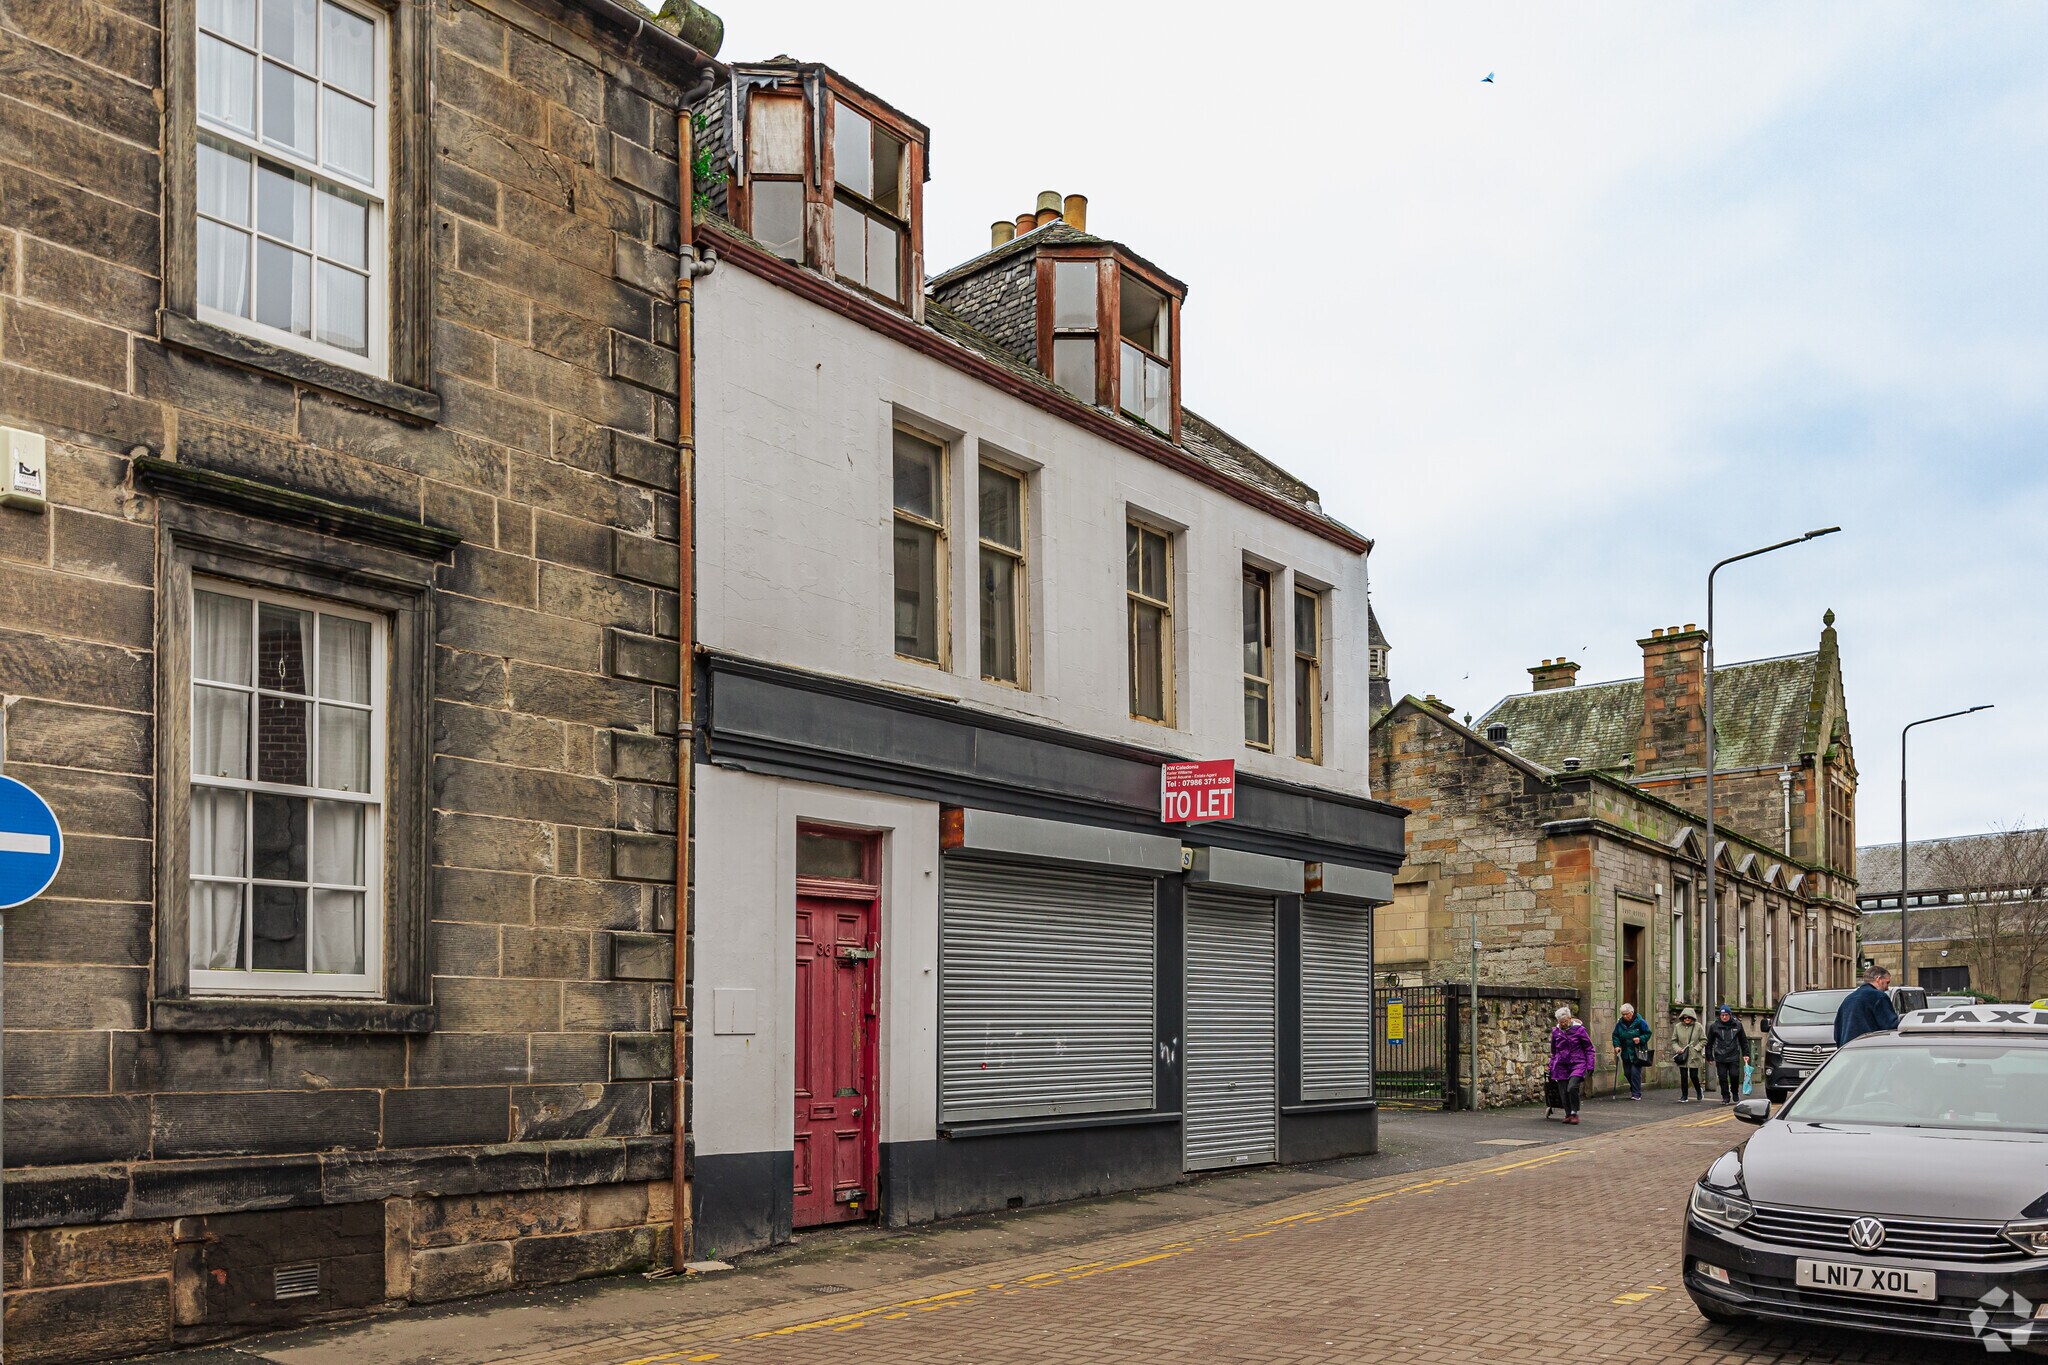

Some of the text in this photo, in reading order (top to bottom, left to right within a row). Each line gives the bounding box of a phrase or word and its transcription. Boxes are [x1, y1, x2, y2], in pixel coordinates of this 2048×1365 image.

[1166, 788, 1233, 819] TO LET
[817, 942, 831, 958] 36
[1917, 1010, 2048, 1025] TAXI
[1812, 1263, 1918, 1294] LN17 XOL
